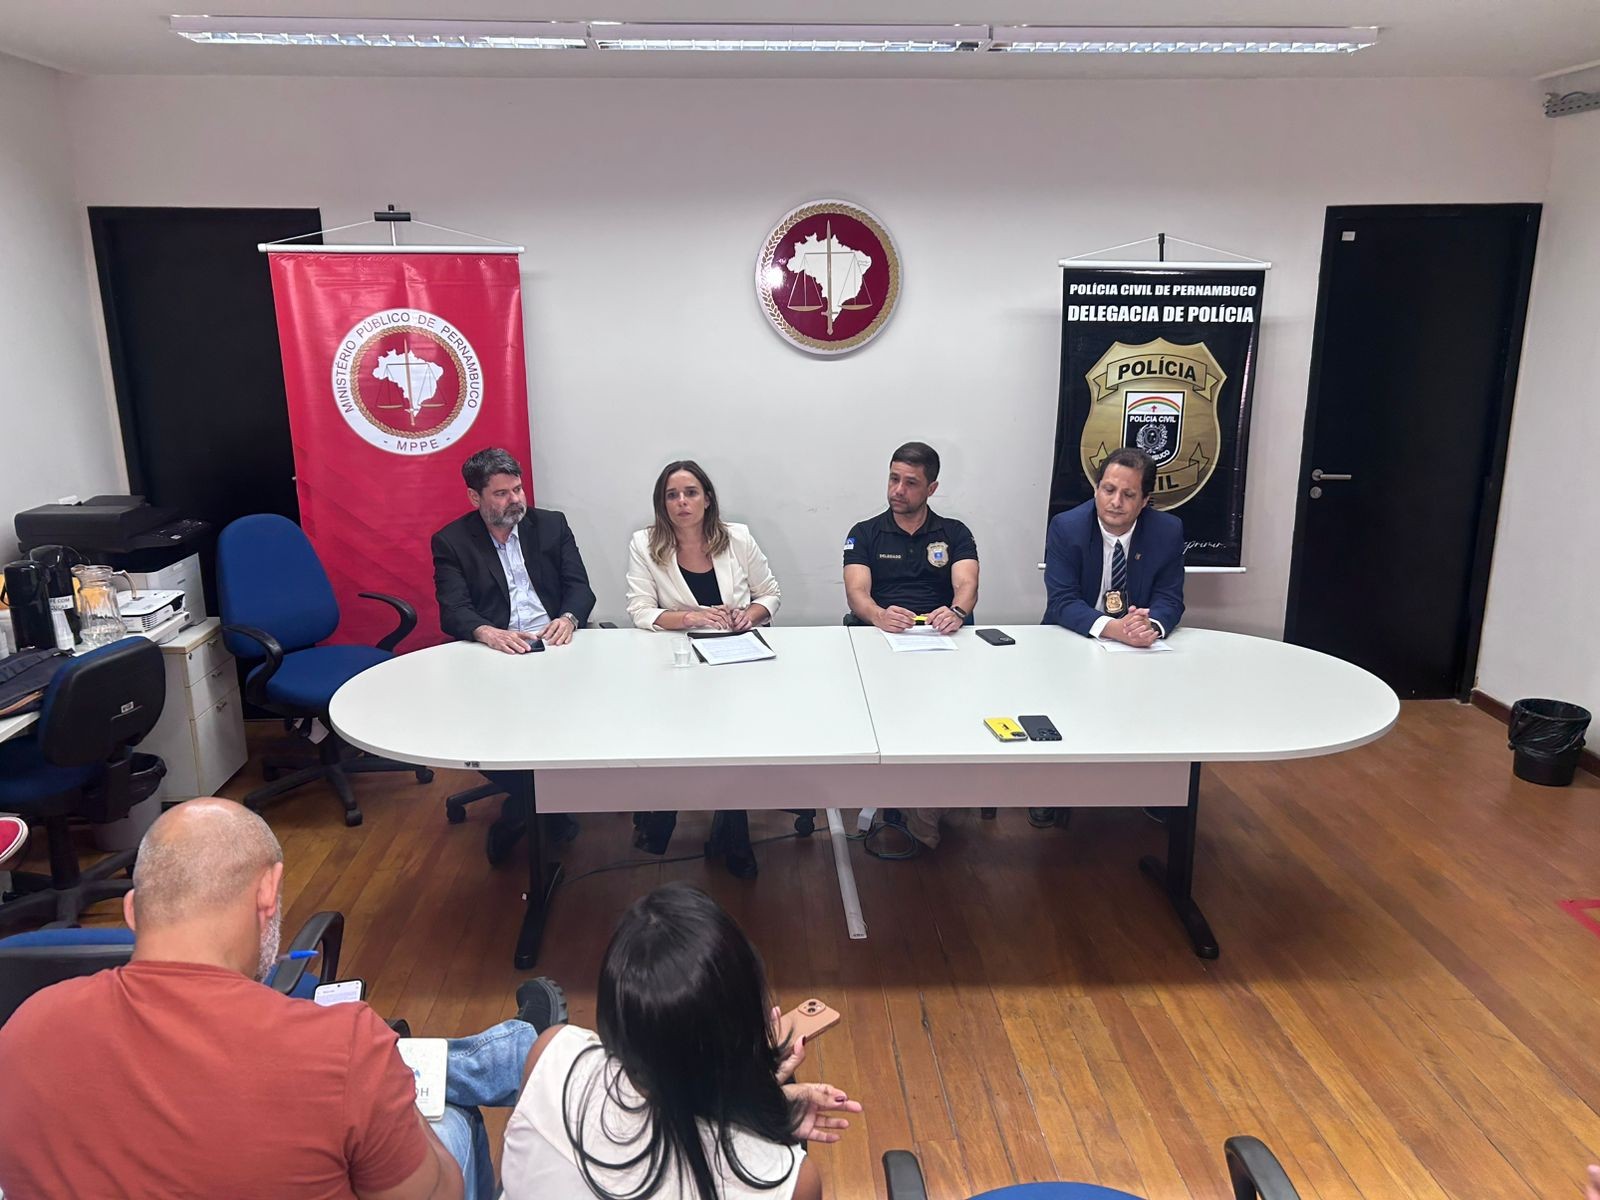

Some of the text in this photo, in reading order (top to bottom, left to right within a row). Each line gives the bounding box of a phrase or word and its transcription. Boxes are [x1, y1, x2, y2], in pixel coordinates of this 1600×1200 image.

[1069, 282, 1257, 297] POLÍCIA CIVIL DE PERNAMBUCO
[1067, 304, 1254, 323] DELEGACIA DE POLÍCIA
[335, 312, 480, 413] MINISTÉRIO PÚBLICO DE PERNAMBUCO
[1117, 356, 1197, 382] POLÍCIA
[1129, 414, 1177, 423] POLÍCIA CIVIL
[396, 439, 439, 452] MPPE
